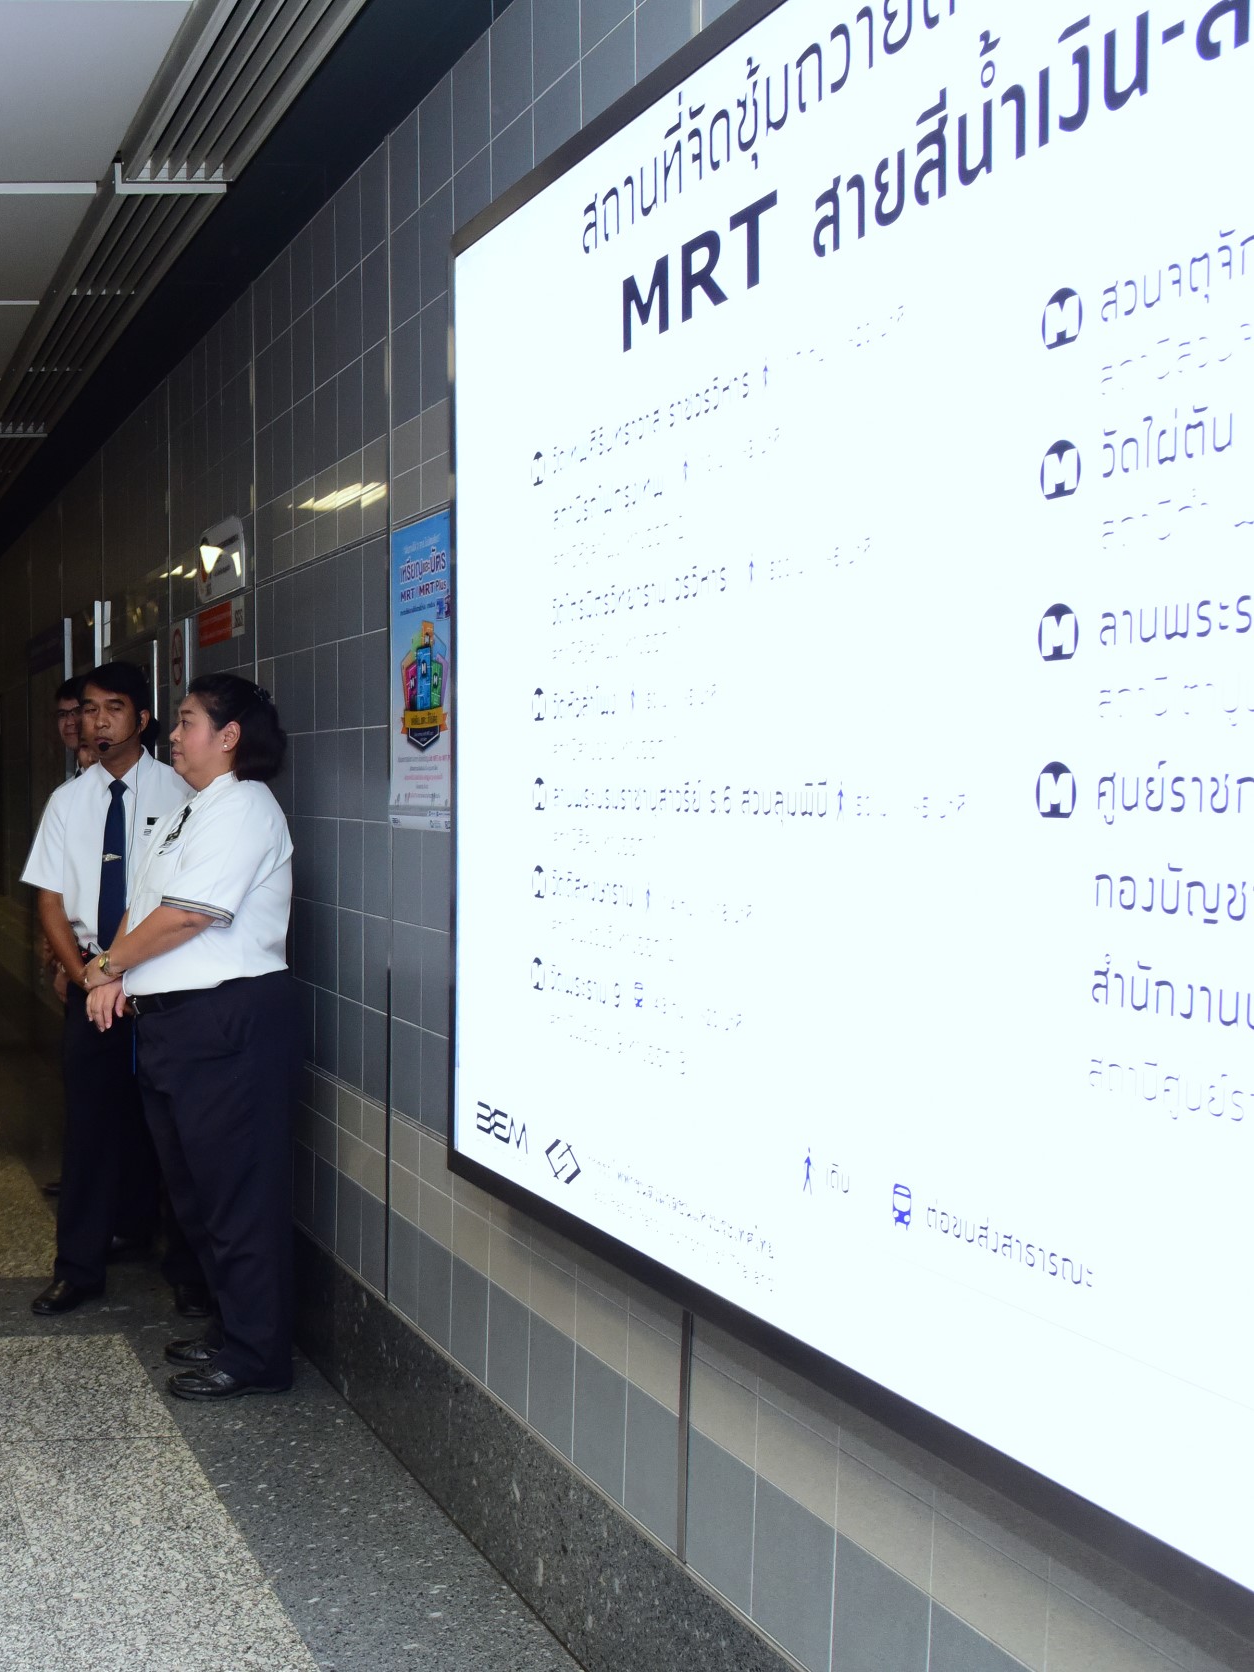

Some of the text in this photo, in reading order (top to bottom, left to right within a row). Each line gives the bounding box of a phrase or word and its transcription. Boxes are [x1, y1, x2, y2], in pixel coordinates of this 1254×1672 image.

[623, 189, 778, 353] MRT
[1102, 405, 1232, 478] วัดไผ่ตัน
[1095, 863, 1254, 924] กองบัญช
